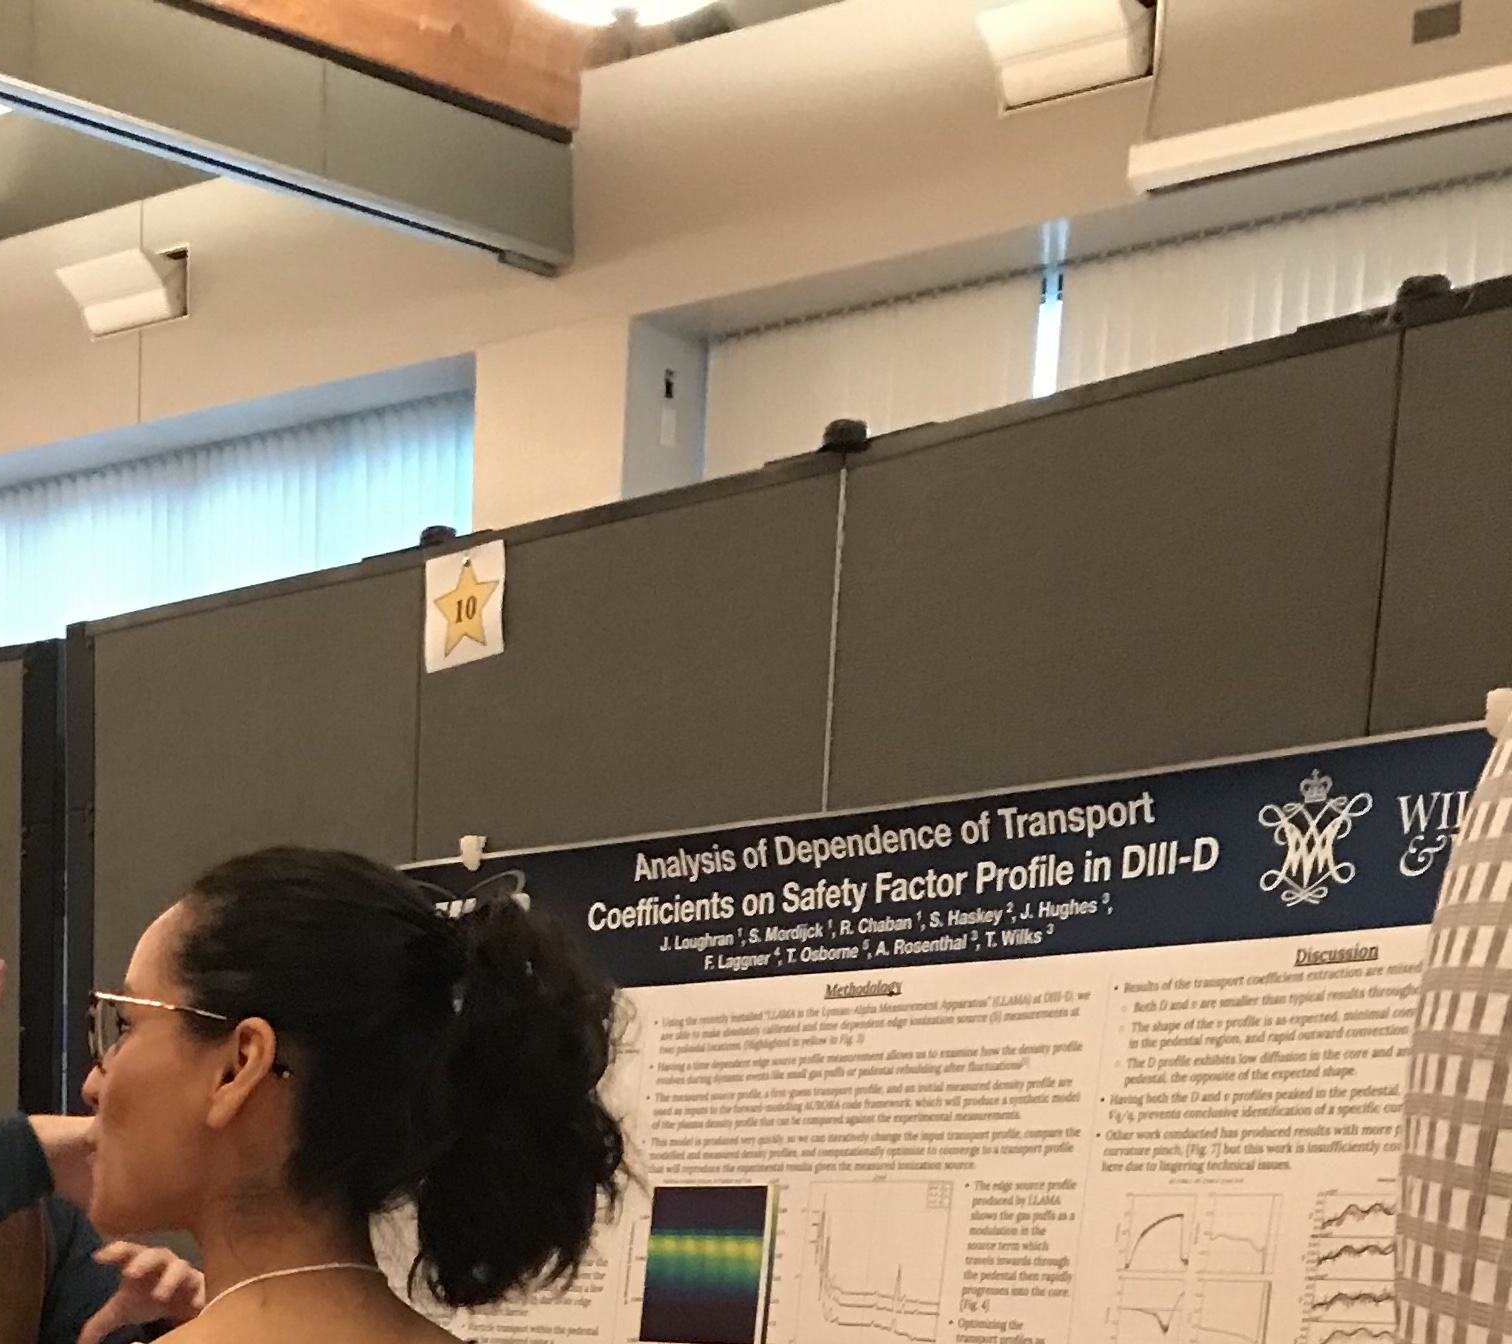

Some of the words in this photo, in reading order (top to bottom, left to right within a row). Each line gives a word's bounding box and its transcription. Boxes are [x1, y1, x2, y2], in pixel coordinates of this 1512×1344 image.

[455, 595, 477, 624] 10
[634, 844, 736, 882] Analysis
[743, 838, 767, 869] of
[774, 824, 951, 868] Dependence
[961, 811, 990, 844] of
[997, 791, 1155, 838] Transport
[588, 890, 735, 931] Coefficients
[742, 890, 775, 917] on
[782, 878, 868, 913] Safety
[875, 869, 968, 903] Factor
[976, 854, 1074, 895] Profile
[1084, 850, 1112, 882] in
[1122, 836, 1219, 880] DIII-D
[660, 936, 671, 951] J.
[674, 933, 734, 951] Loughran
[749, 928, 762, 943] S.
[764, 923, 823, 943] Mordijck
[840, 920, 854, 936] R.
[858, 916, 912, 934] Chaban
[930, 911, 943, 928] S.
[948, 907, 1003, 926] Haskey
[1020, 903, 1034, 920] J.
[1038, 898, 1098, 920] Hughes
[704, 955, 715, 970] F.
[718, 953, 771, 971] Laggner
[787, 948, 797, 963] T.
[800, 946, 859, 962] Osborne
[875, 941, 890, 956] A.
[893, 934, 967, 955] Rosenthal
[985, 932, 997, 947] T.
[1001, 928, 1042, 946] Wilks
[1295, 943, 1379, 965] Discussion
[825, 980, 903, 998] Methodology
